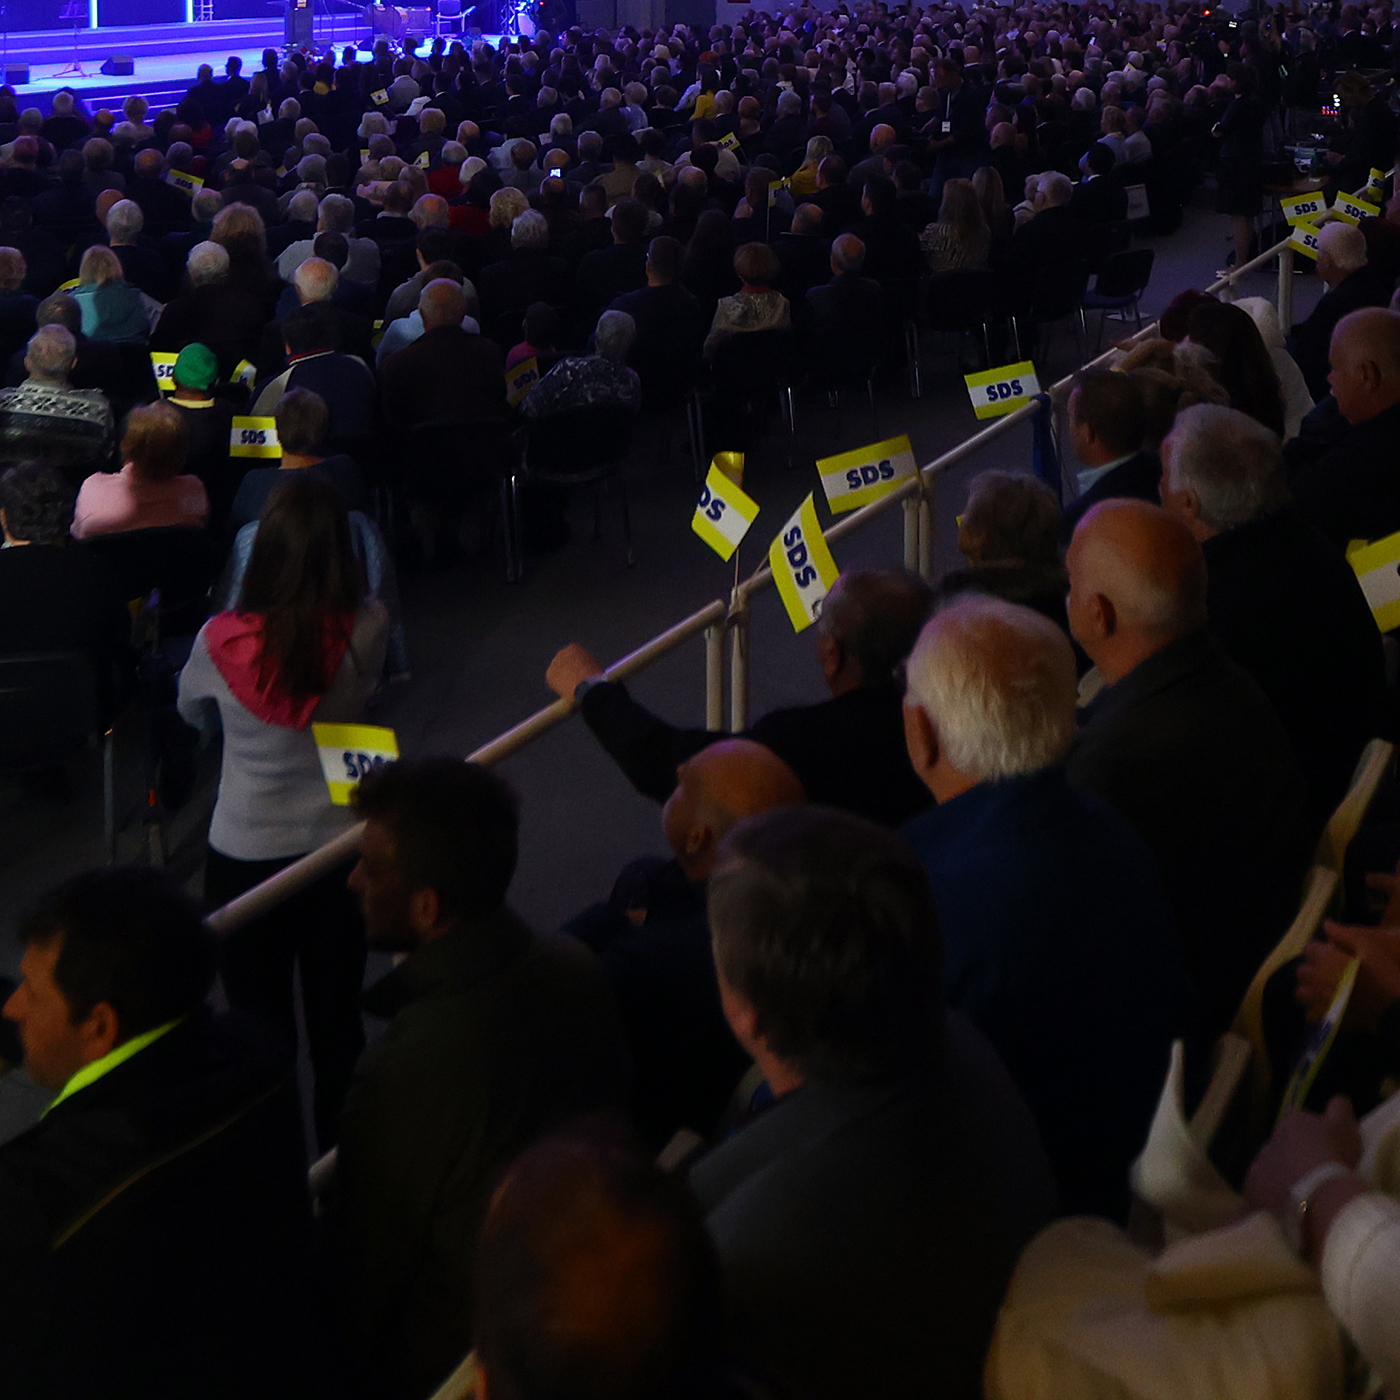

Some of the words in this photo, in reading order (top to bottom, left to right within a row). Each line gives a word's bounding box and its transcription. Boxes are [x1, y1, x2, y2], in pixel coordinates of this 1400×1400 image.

[1294, 201, 1318, 216] SDS
[986, 378, 1024, 403] SDS
[241, 428, 267, 445] SDS
[846, 460, 895, 491] SDS
[783, 526, 817, 589] SDS
